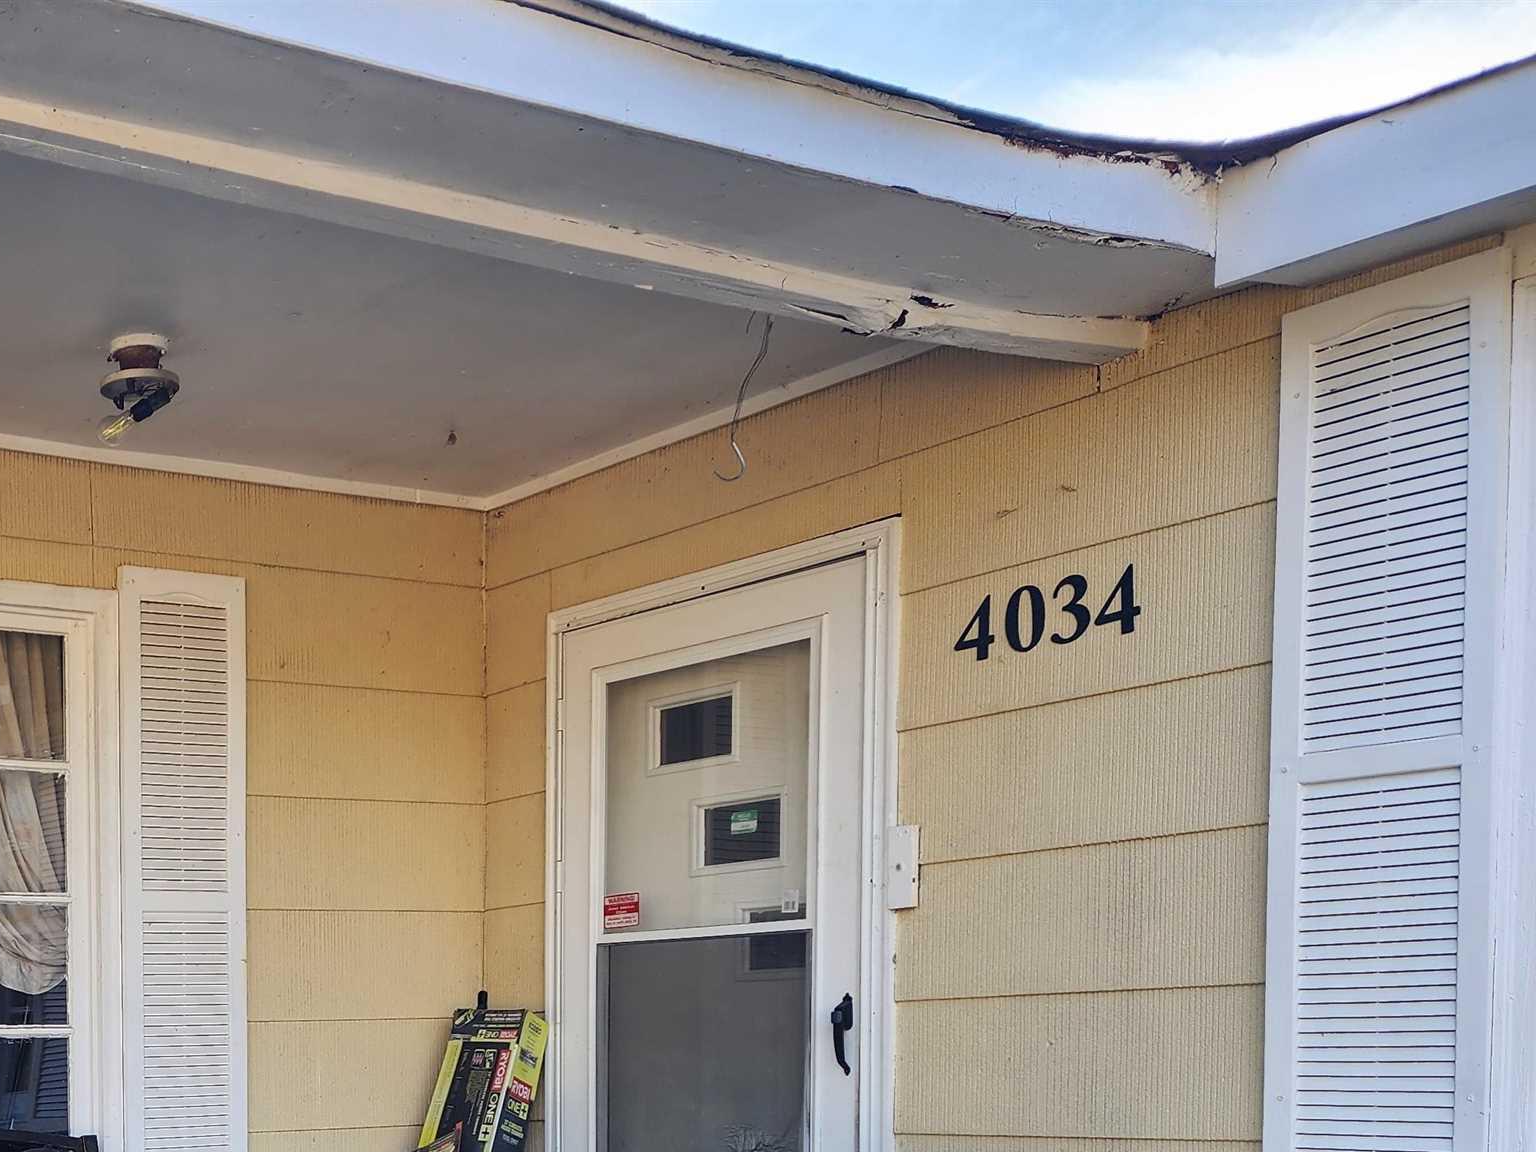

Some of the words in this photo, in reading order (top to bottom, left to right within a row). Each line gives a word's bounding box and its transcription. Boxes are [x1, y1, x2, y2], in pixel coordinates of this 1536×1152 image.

[953, 563, 1141, 661] 4034
[493, 1051, 509, 1090] RYOBI
[511, 1079, 531, 1101] RYOBI
